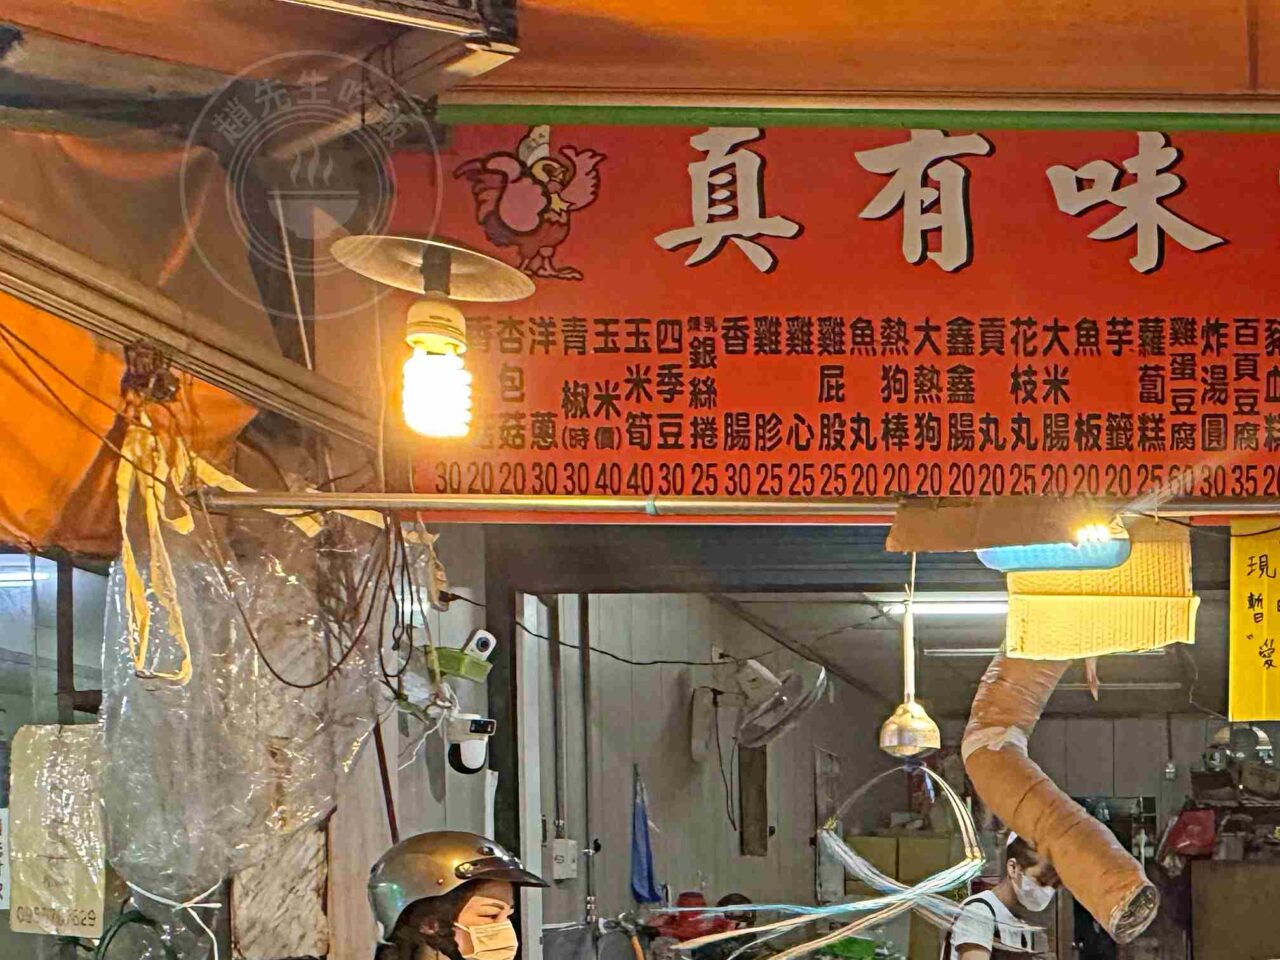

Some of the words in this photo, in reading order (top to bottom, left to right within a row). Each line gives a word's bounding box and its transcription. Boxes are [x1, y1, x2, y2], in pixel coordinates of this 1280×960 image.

[529, 316, 559, 450] 洋蔥
[561, 317, 590, 419] 青椒
[593, 318, 621, 419] 玉米
[624, 318, 652, 450] 玉米筍
[656, 319, 684, 450] 四季豆
[721, 316, 750, 451] 香腸
[785, 316, 815, 451] 雞心
[817, 316, 847, 451] 雞屁股
[849, 316, 878, 451] 魚丸
[880, 316, 911, 451] 熱狗棒
[913, 317, 943, 451] 大熱狗
[946, 316, 976, 451] 鑫鑫腸
[978, 317, 1007, 451] 貢丸
[1010, 316, 1039, 451] 花枝丸
[1042, 317, 1071, 451] 大米腸
[1074, 317, 1102, 451] 魚板
[1137, 317, 1166, 452] 蘿蔔糕
[1169, 317, 1197, 451] 雞蛋豆腐
[1233, 318, 1261, 451] 百頁豆腐
[435, 461, 461, 494] 30
[467, 462, 494, 495] 20
[499, 462, 526, 495] 20
[531, 462, 558, 495] 30
[563, 462, 589, 495] 30
[594, 462, 621, 495] 40
[626, 462, 653, 495] 40
[659, 463, 684, 495] 30
[691, 463, 718, 495] 25
[725, 463, 750, 495] 30
[756, 463, 782, 495] 25
[788, 463, 814, 495] 25
[820, 463, 847, 495] 25
[851, 463, 877, 495] 20
[883, 463, 910, 495] 20
[915, 463, 942, 495] 20
[949, 463, 975, 495] 20
[979, 463, 1006, 495] 20
[1009, 464, 1037, 495] 25
[1041, 464, 1067, 495] 20
[1073, 464, 1099, 495] 20
[1105, 464, 1131, 495] 20
[1137, 464, 1164, 495] 25
[1200, 464, 1226, 495] 30
[1231, 464, 1258, 495] 35
